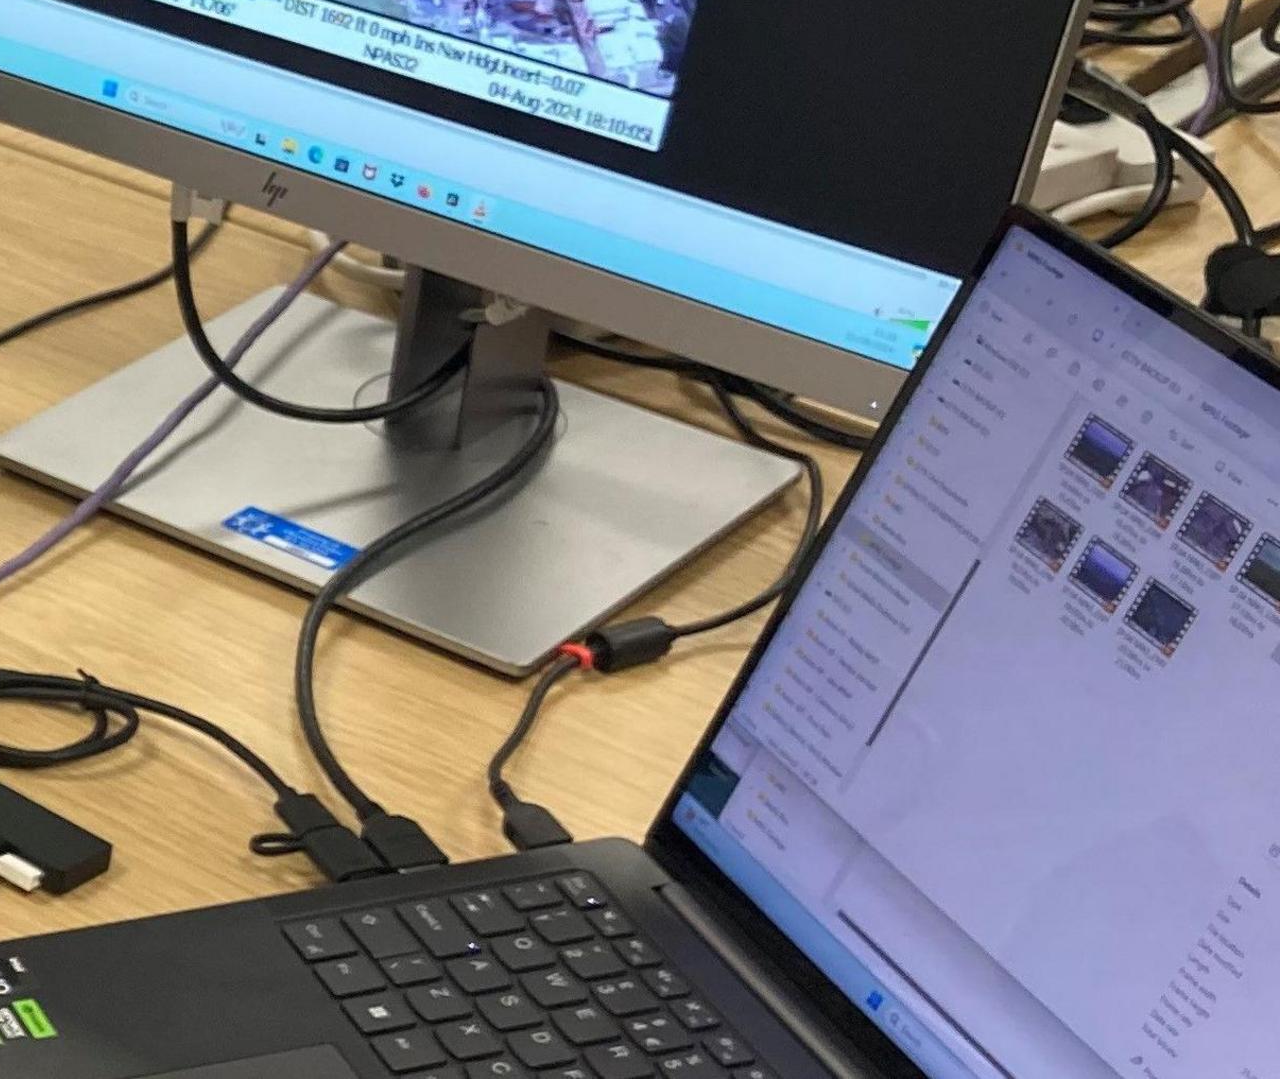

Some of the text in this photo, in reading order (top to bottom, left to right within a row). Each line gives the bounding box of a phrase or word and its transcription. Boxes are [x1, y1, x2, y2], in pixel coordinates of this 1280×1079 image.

[378, 24, 413, 51] mph
[361, 43, 419, 73] NPAS32
[486, 81, 581, 123] 04-Aug-2024
[261, 172, 288, 207] hp
